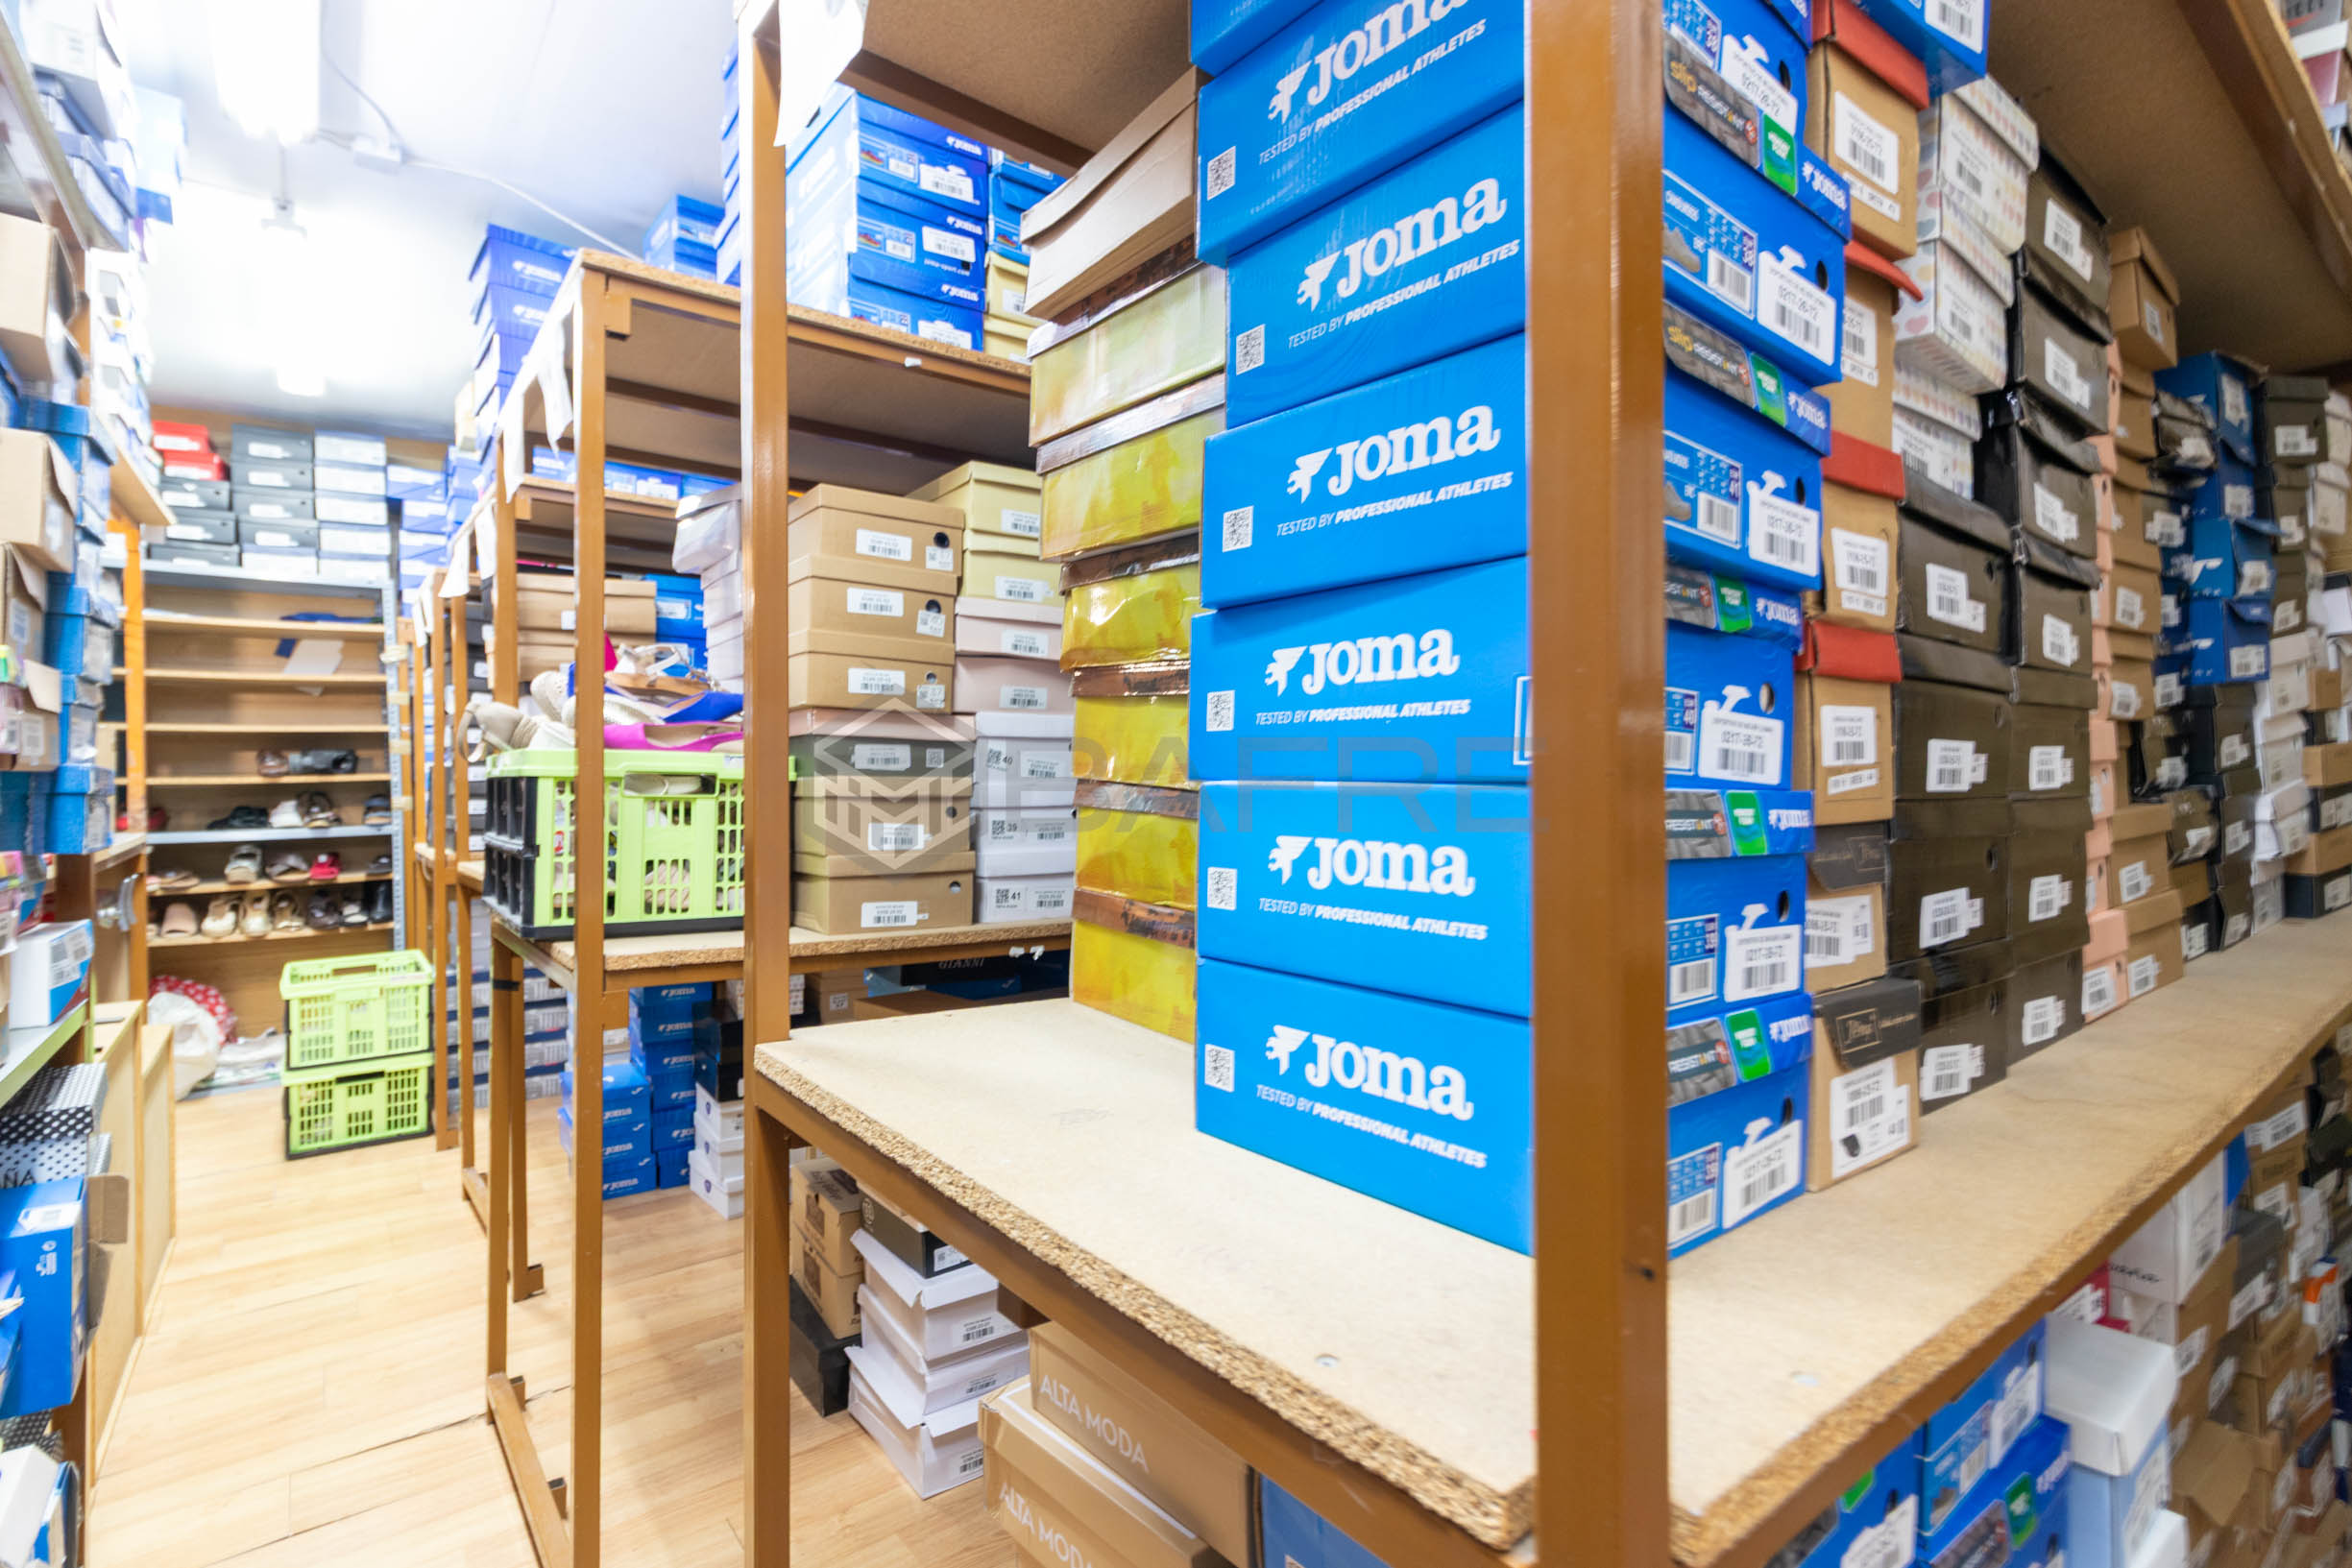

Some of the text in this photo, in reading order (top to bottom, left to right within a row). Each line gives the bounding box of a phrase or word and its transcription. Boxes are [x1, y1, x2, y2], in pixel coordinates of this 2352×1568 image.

[1259, 19, 1487, 165] TESTED BY PROFESSIONAL ATHLETES
[1288, 239, 1520, 349] TESTED BY PROFESSIONAL ATHLETES
[1276, 471, 1515, 538] TESTED BY PROFESSIONAL ATHLETES
[1255, 699, 1472, 726] TESTED BY PROFESSIONAL ATHLETES
[1010, 890, 1021, 902] 41
[1258, 897, 1489, 941] TESTED BY PROFESSIONAL ATHLETES
[1256, 1083, 1488, 1170] TESTED BY PROFESSIONAL ATHLETES
[1040, 1374, 1150, 1474] ALTA MODA
[999, 1482, 1093, 1568] ALTA MOD
